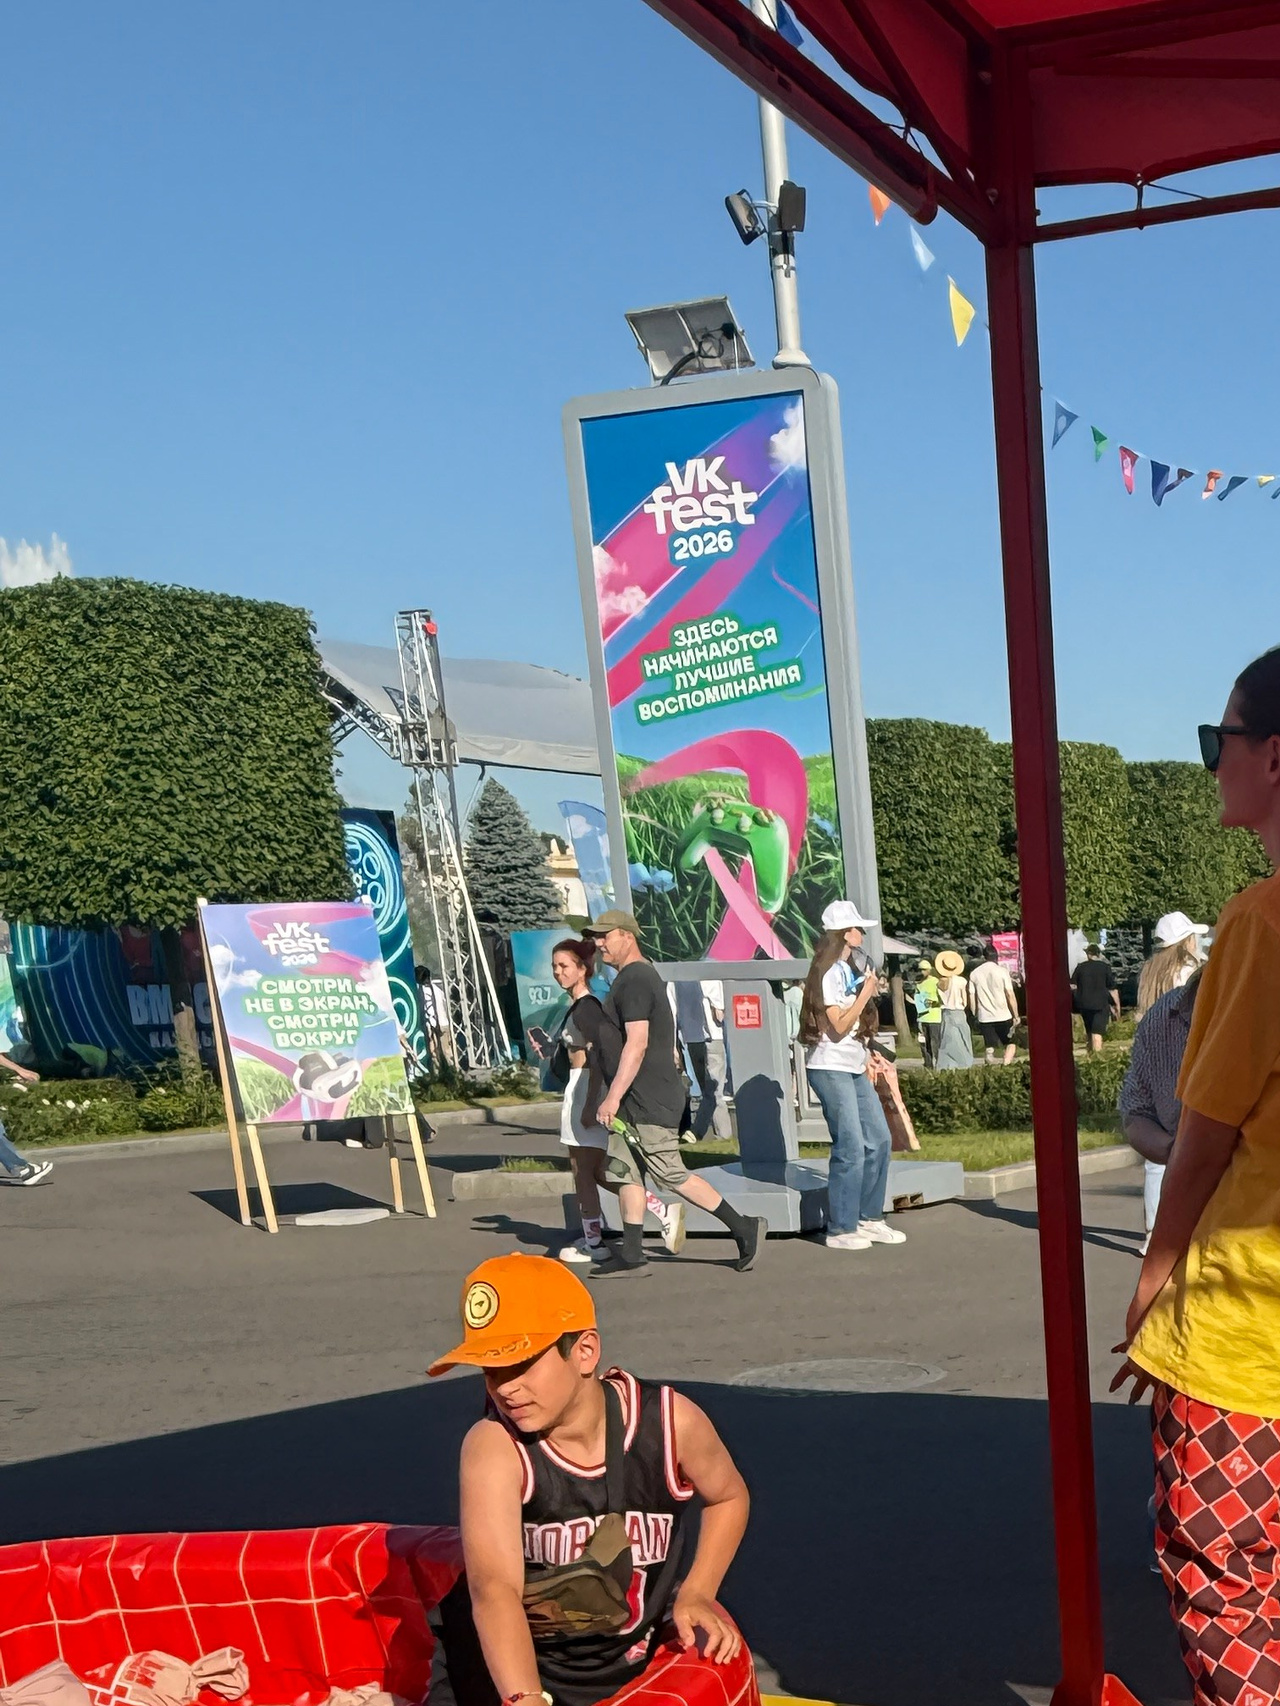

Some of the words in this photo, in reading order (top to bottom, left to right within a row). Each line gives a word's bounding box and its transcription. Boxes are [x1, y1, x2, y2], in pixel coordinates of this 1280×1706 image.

[665, 456, 729, 496] VK
[643, 481, 758, 535] fest
[673, 529, 733, 561] 2026
[673, 617, 738, 648] ЗДЕСЬ
[643, 627, 777, 677] НАЧИНАЮТСЯ
[674, 655, 755, 691] ЛУЧШИЕ
[638, 664, 800, 721] ВОСПОМИНАНИЯ
[262, 932, 330, 955] fest
[272, 922, 312, 938] VK
[261, 978, 352, 995] СМОТРИ
[246, 998, 274, 1014] НЕ
[280, 998, 294, 1012] В
[298, 995, 375, 1014] ЭКРАН,
[268, 1013, 359, 1029] СМОТРИ
[275, 1030, 358, 1047] ВОКРУГ
[523, 1510, 674, 1567] JORAN
